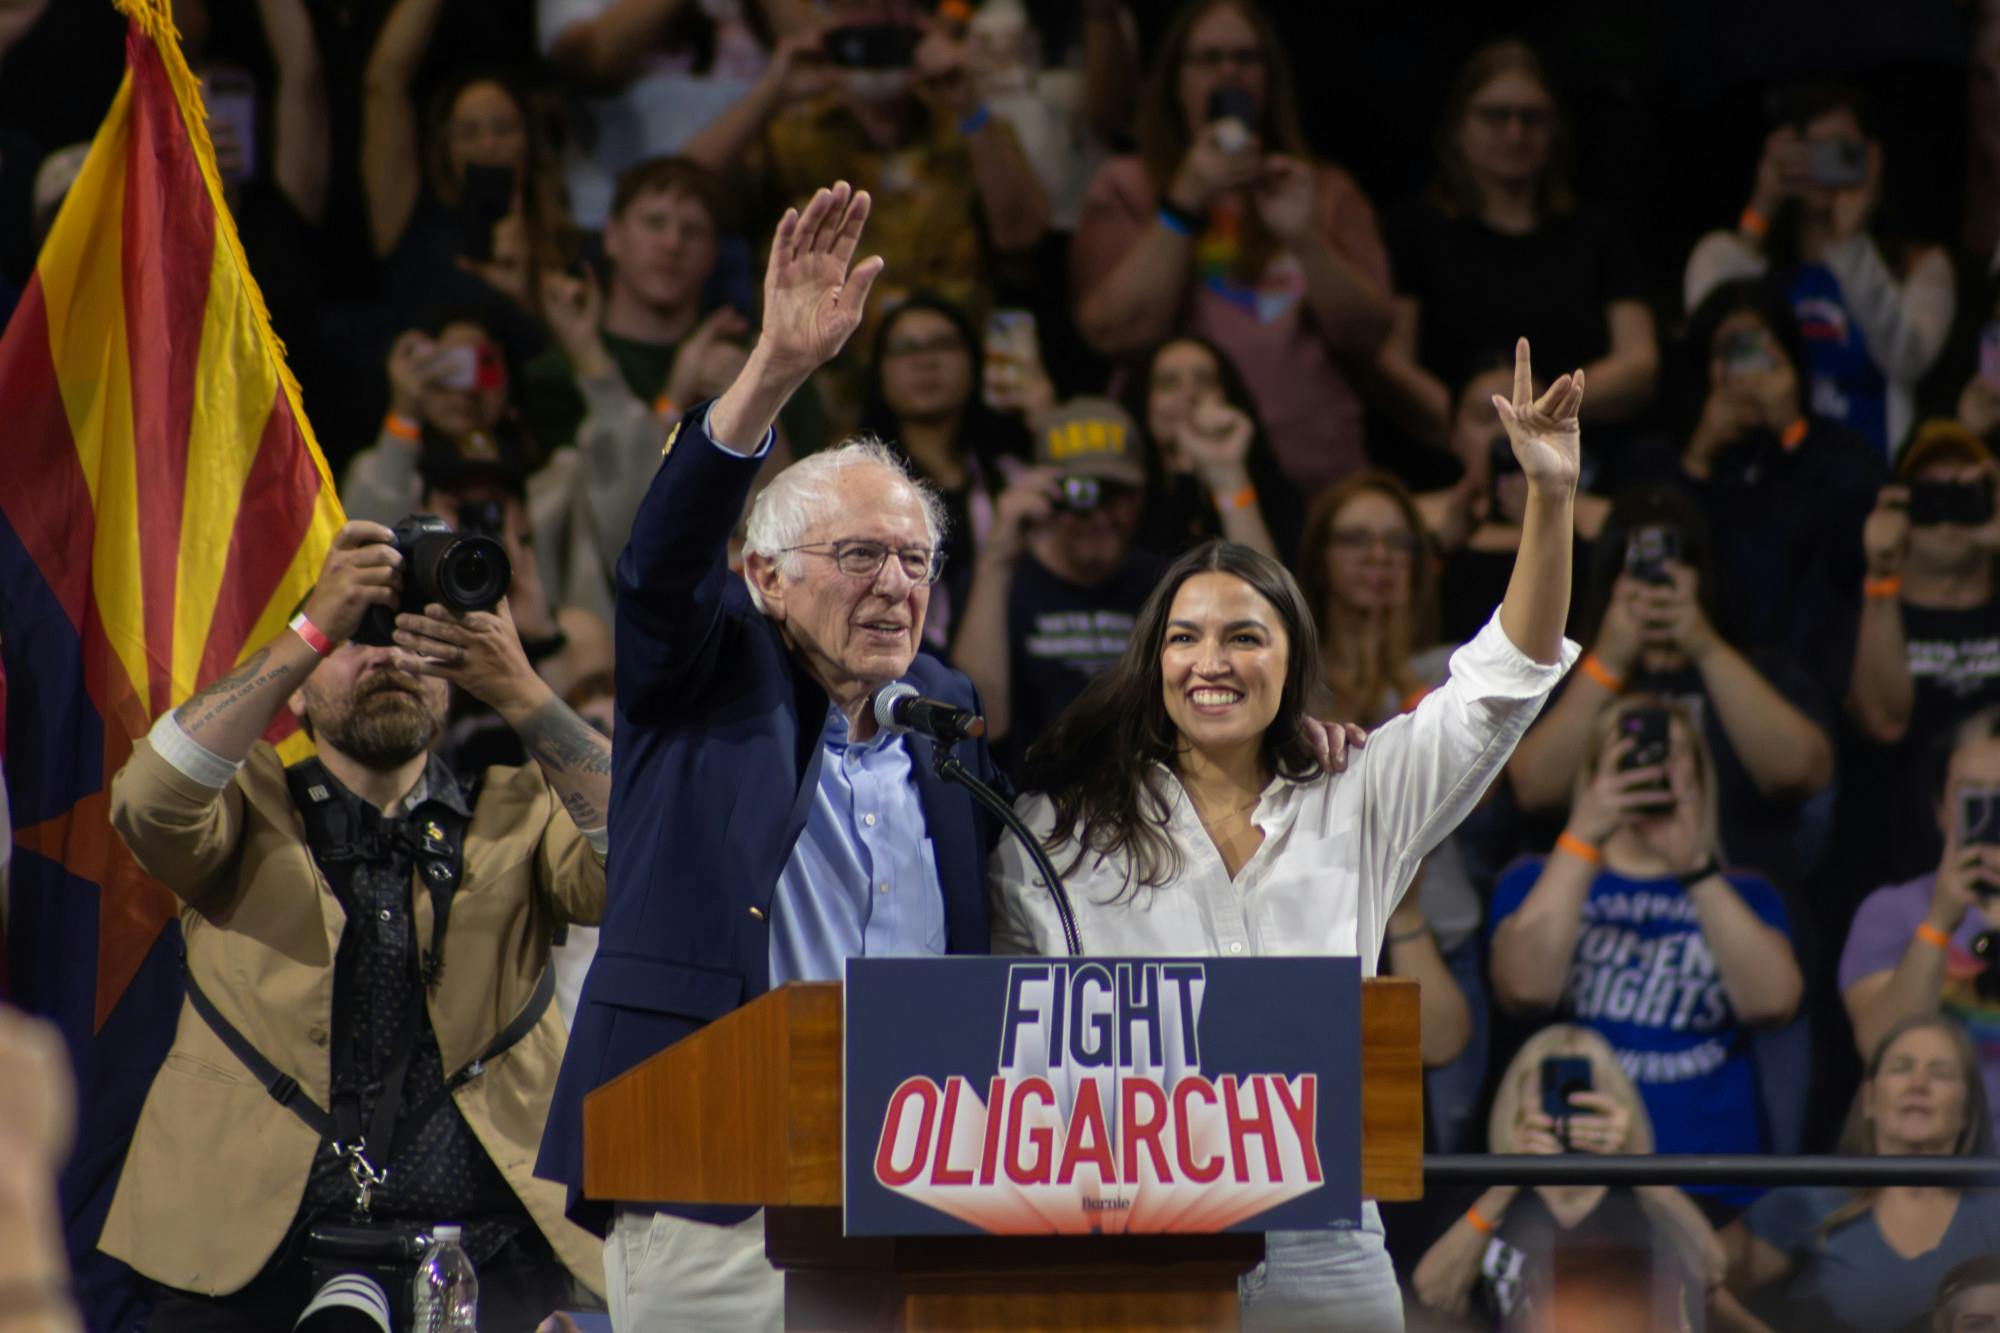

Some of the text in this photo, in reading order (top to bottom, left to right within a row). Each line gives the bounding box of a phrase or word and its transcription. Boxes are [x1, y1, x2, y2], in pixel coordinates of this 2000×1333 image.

[1577, 922, 1716, 979] OMEN
[1000, 963, 1206, 1068] FIGHT
[1574, 963, 1726, 1029] RIGHTS
[874, 1074, 1325, 1187] OLIGARCHY
[1082, 1196, 1130, 1210] Bernie
